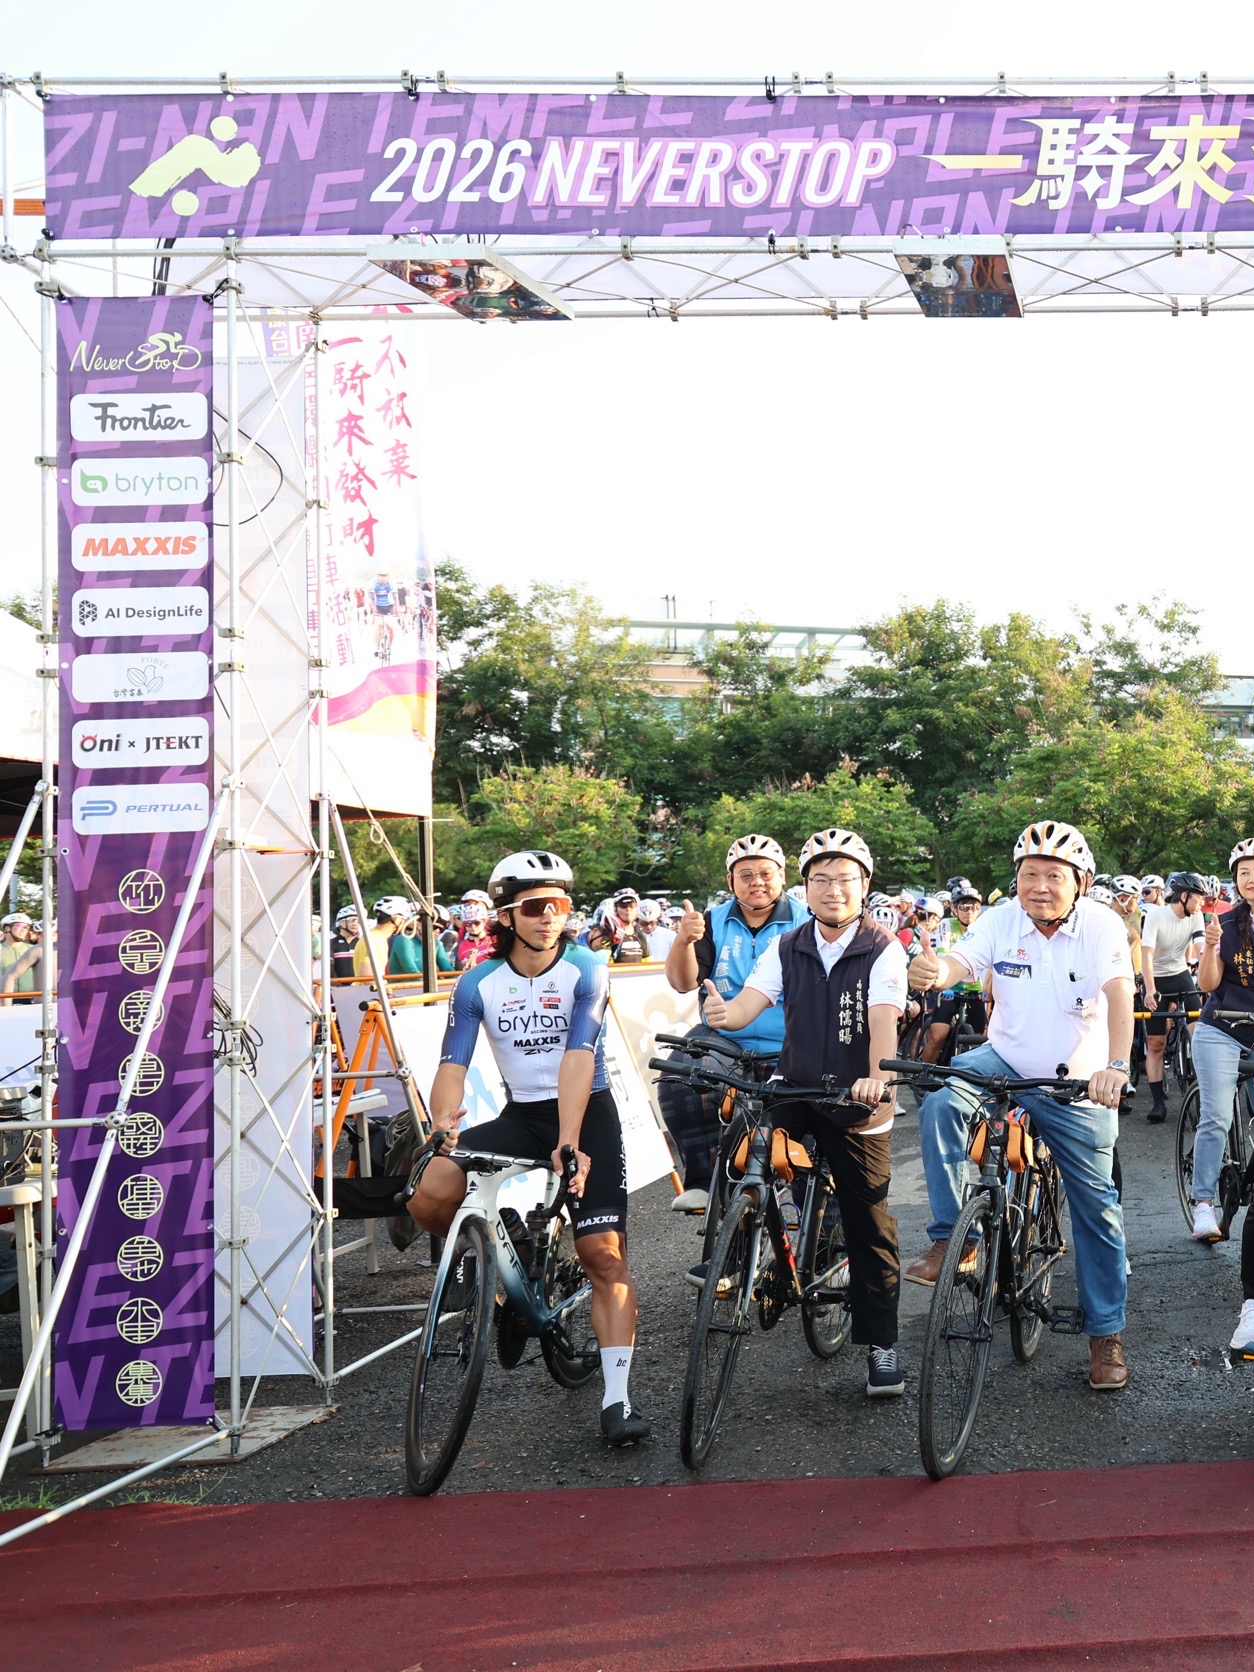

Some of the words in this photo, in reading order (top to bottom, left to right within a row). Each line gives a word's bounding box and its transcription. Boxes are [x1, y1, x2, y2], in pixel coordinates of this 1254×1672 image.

[370, 138, 532, 203] 2026
[531, 138, 892, 207] NEVERSTOP
[87, 402, 191, 433] Frontier
[115, 472, 198, 496] bryton
[82, 536, 197, 557] MAXXIS
[105, 607, 120, 619] AI
[125, 605, 203, 620] DesignLife
[144, 736, 203, 753] JTEKT
[125, 803, 203, 813] PERTUAL
[498, 1011, 568, 1033] bryton
[514, 1036, 560, 1047] MAXXIS
[576, 1215, 620, 1230] MAXXIS
